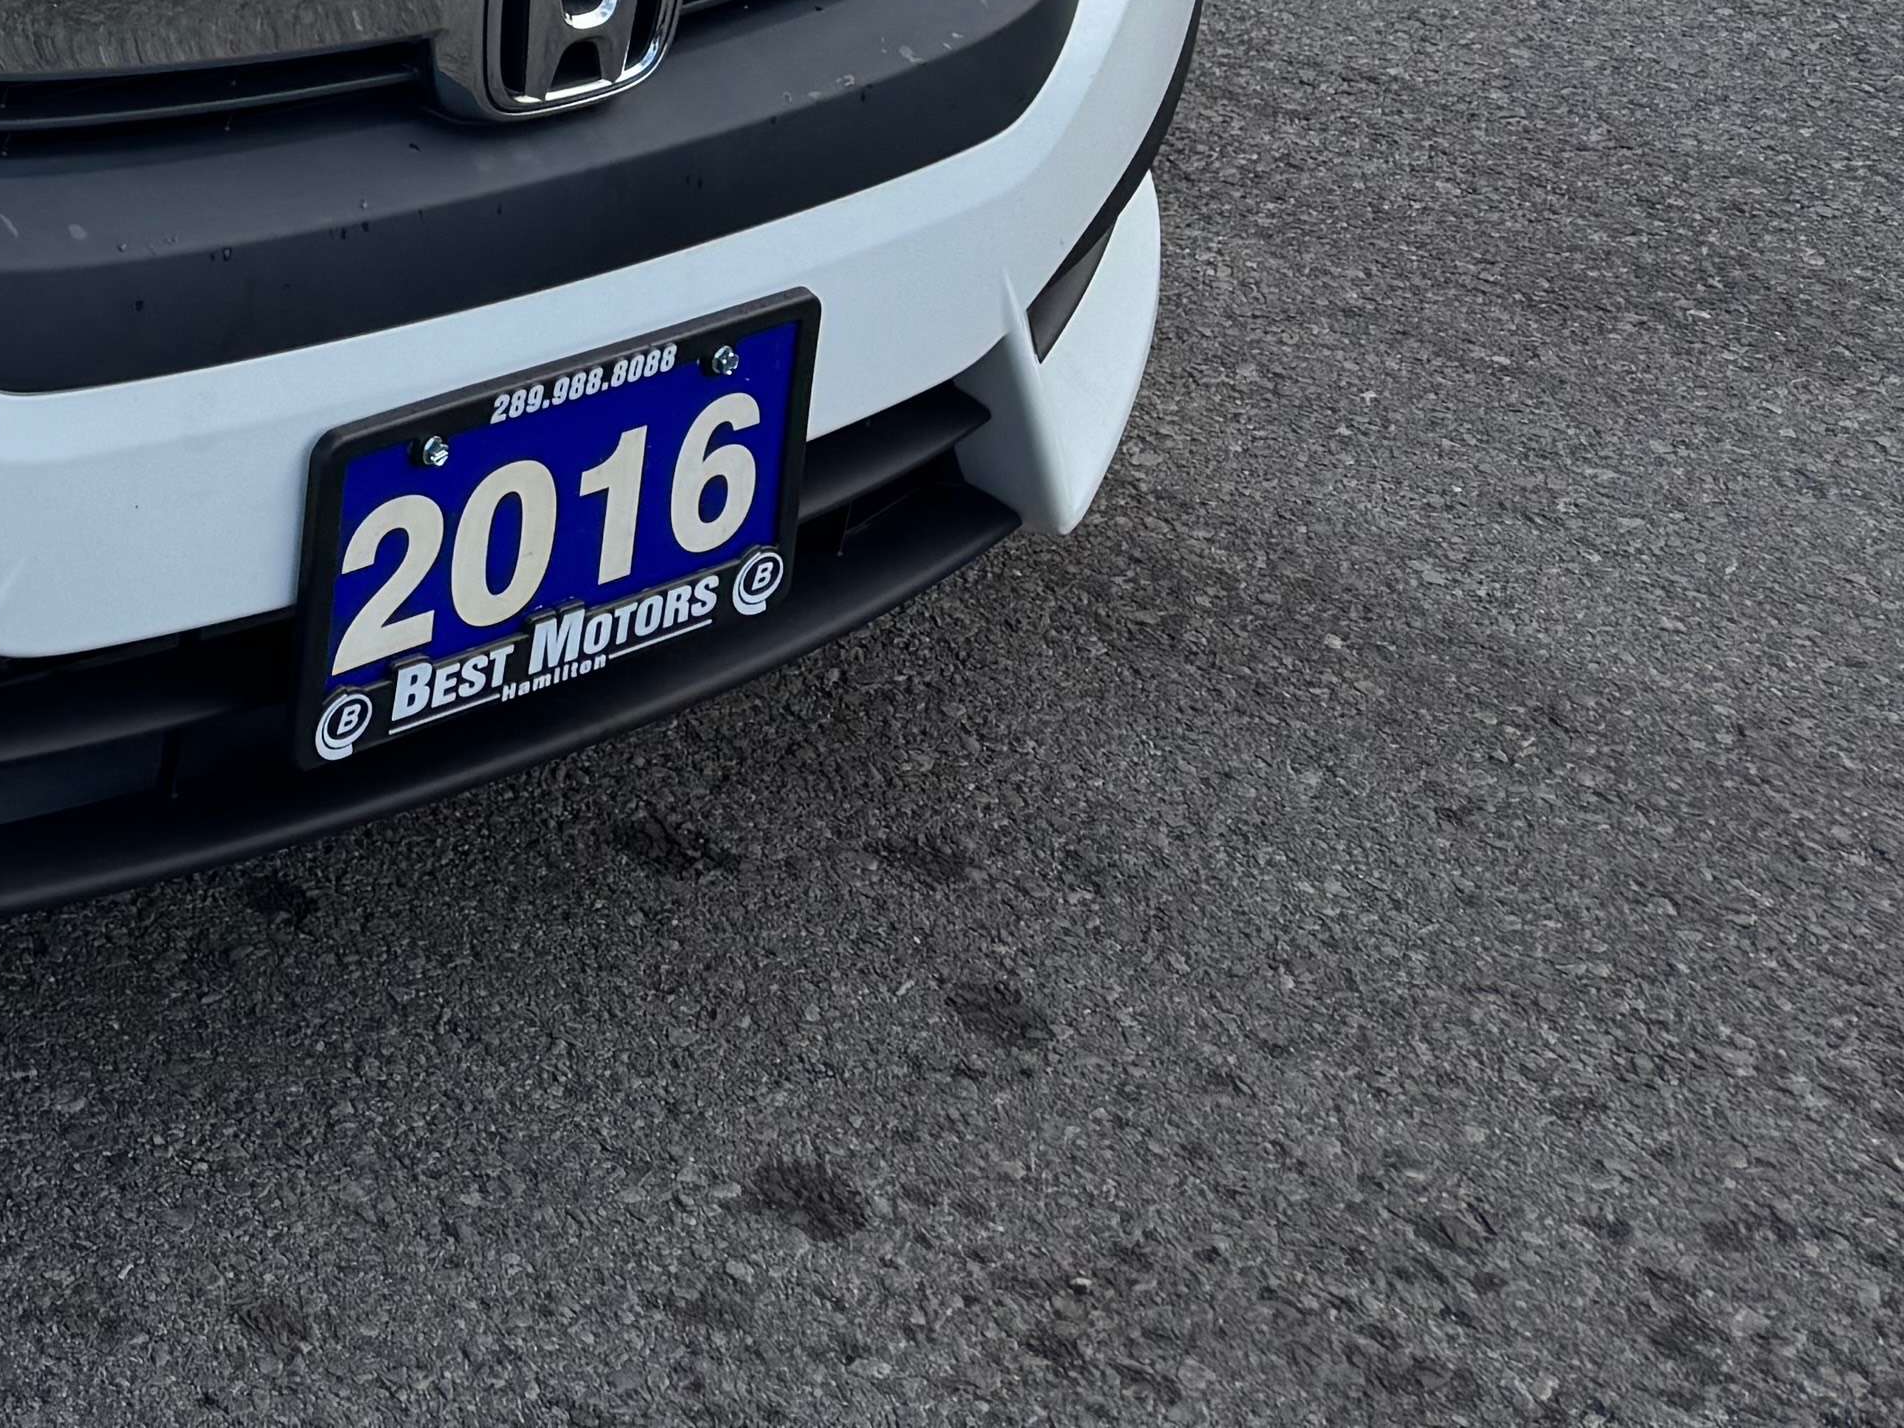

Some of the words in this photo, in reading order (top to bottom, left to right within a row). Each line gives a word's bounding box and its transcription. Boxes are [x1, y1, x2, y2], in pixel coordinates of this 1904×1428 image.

[490, 344, 677, 424] 289.988.8088
[332, 393, 761, 676] 2016
[751, 560, 773, 591] B
[502, 654, 606, 702] Hamilton
[337, 704, 359, 735] B
